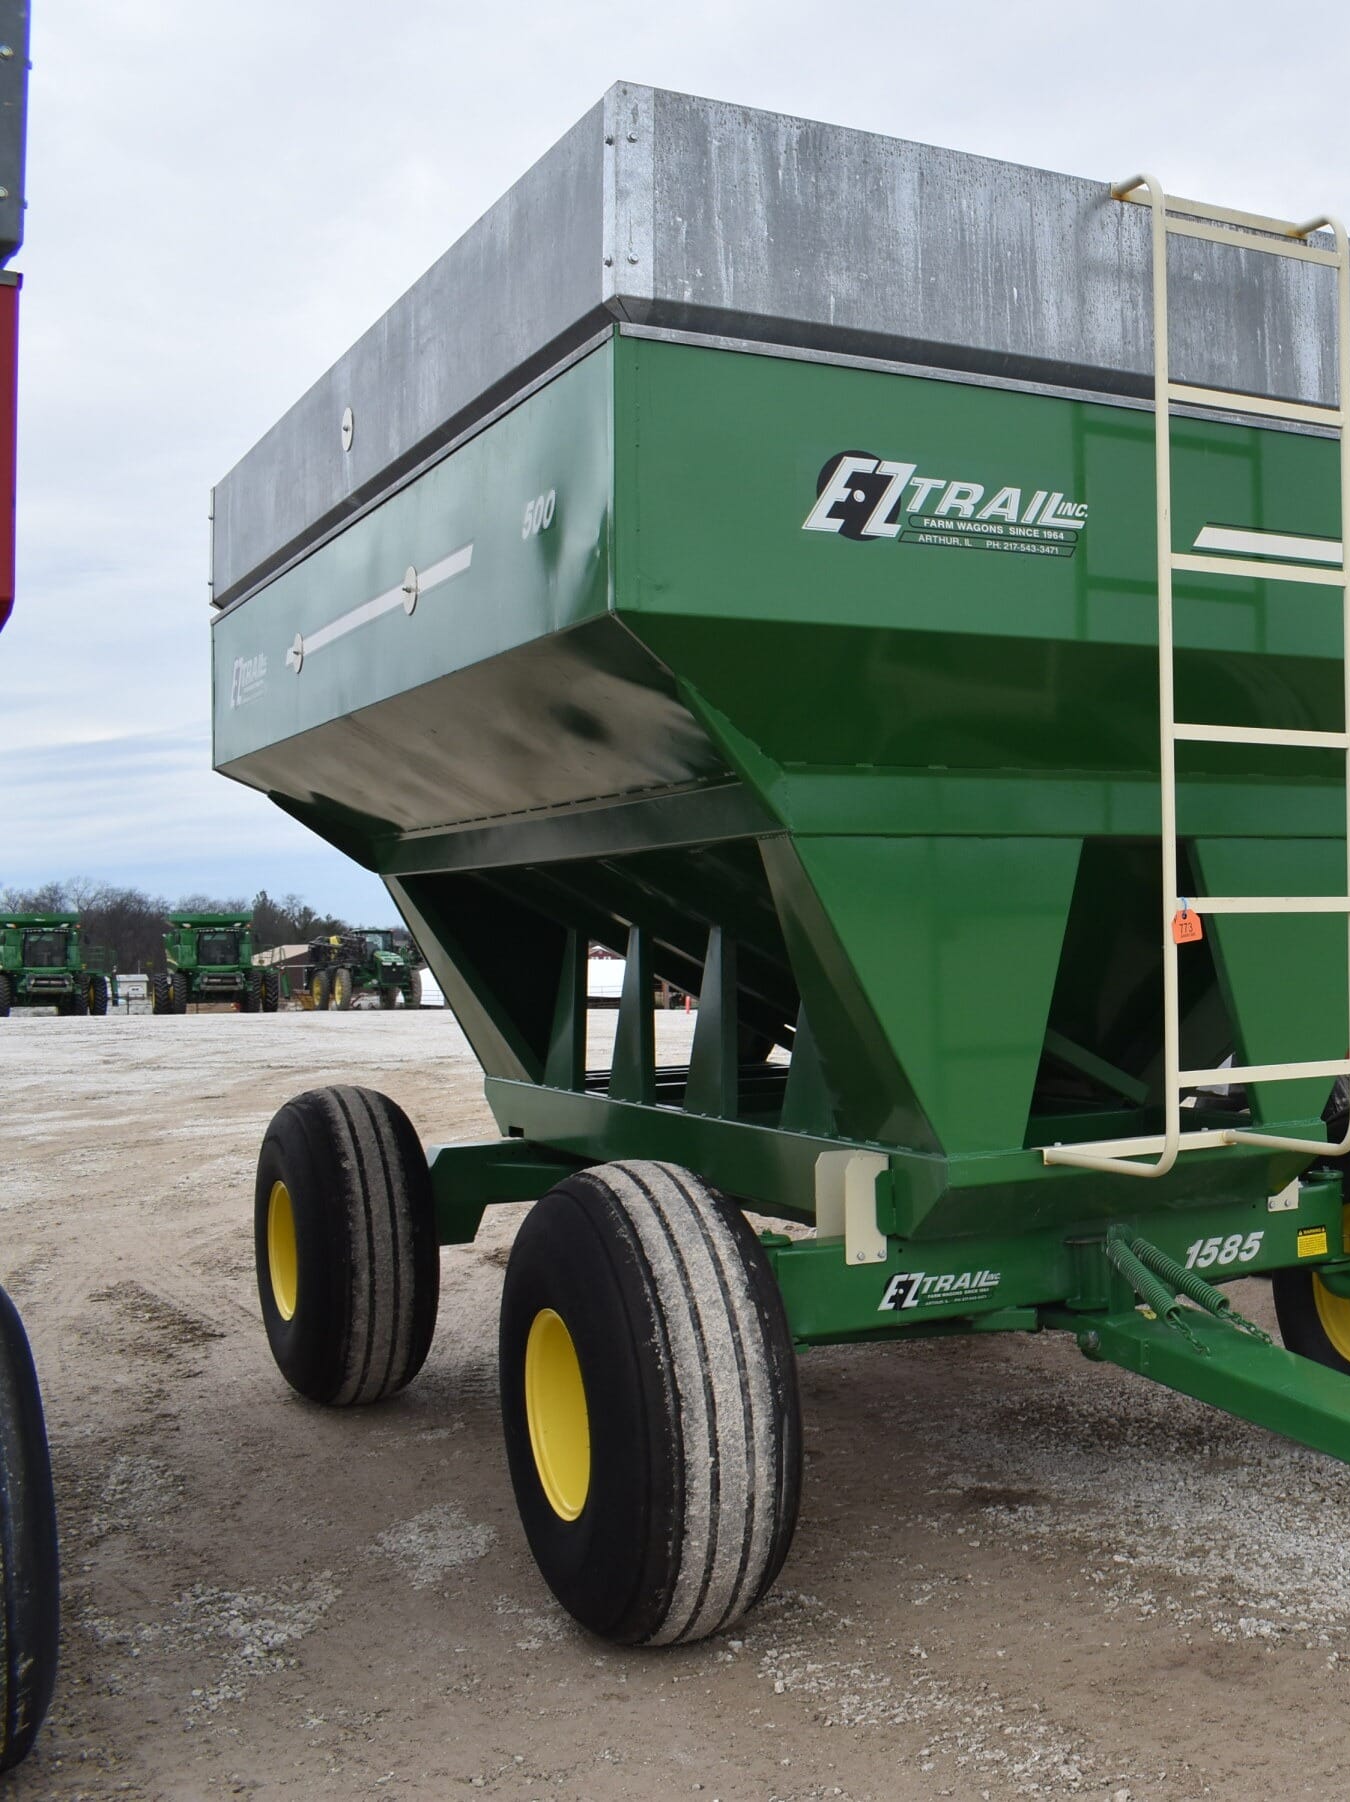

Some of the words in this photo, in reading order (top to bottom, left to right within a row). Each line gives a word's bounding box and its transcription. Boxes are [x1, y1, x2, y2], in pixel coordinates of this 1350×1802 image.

[521, 489, 556, 540] 500
[906, 476, 1086, 529] TRAIL
[1057, 501, 1088, 518] INC.
[923, 519, 954, 529] FARM
[956, 522, 1004, 534] WAGONS
[1009, 527, 1040, 538] SINCE
[1043, 531, 1064, 541] 1964
[964, 539, 973, 547] IL
[1003, 542, 1059, 555] 217-543-3471
[1184, 1230, 1265, 1270] 1585
[921, 1270, 999, 1294] TRAIL
